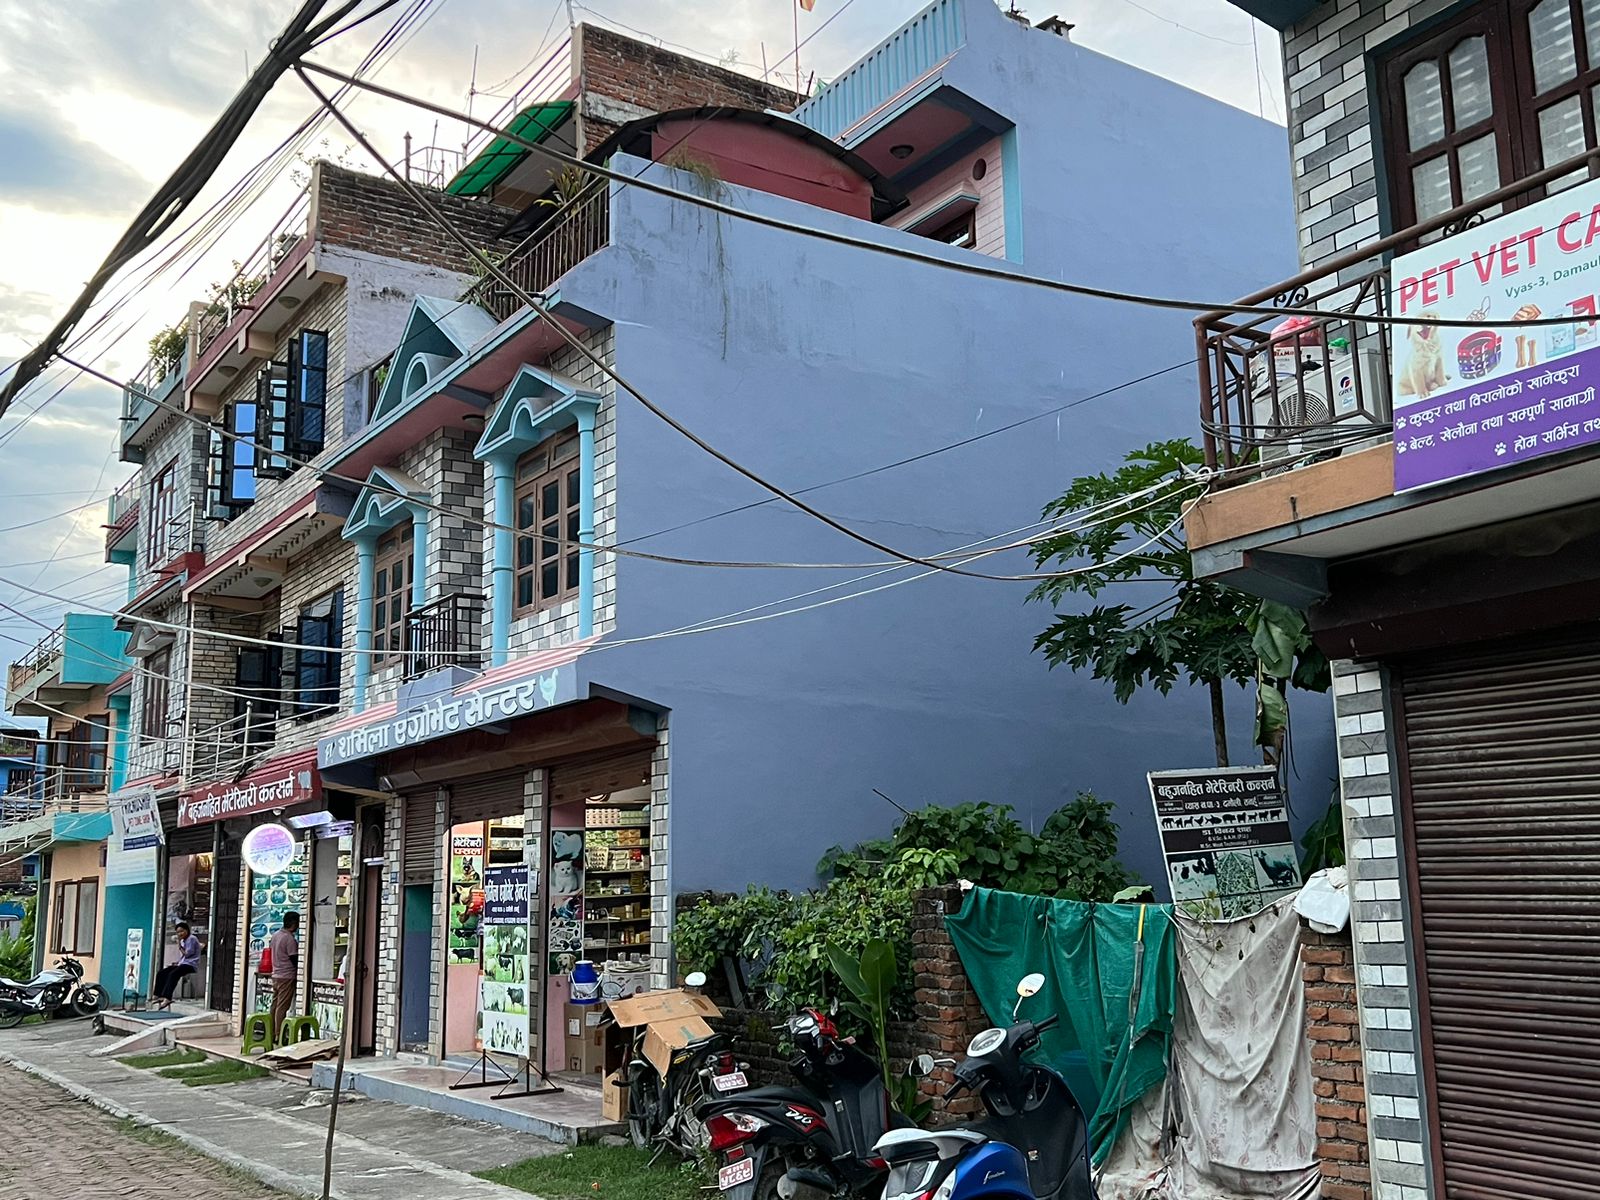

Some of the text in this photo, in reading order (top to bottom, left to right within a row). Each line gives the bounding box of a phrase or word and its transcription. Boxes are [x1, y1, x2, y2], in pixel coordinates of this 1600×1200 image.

[1400, 258, 1460, 315] PET
[1471, 226, 1543, 285] VET
[1505, 276, 1550, 299] Vyas-3,
[1409, 364, 1580, 427] कुकुर तथा विरालोको खानेकुरा
[1440, 421, 1478, 441] खेलौना
[1481, 414, 1504, 430] तथा
[1507, 398, 1546, 423] सम्पूर्ण
[1549, 386, 1595, 411] सामाग्री
[1514, 435, 1538, 453] होम
[1541, 422, 1579, 443] सर्भिस
[338, 724, 391, 759] शर्मिला
[464, 679, 537, 726] सेन्टर
[1157, 780, 1204, 800] बहुजनहित
[1205, 778, 1245, 794] भेटेरिनरी
